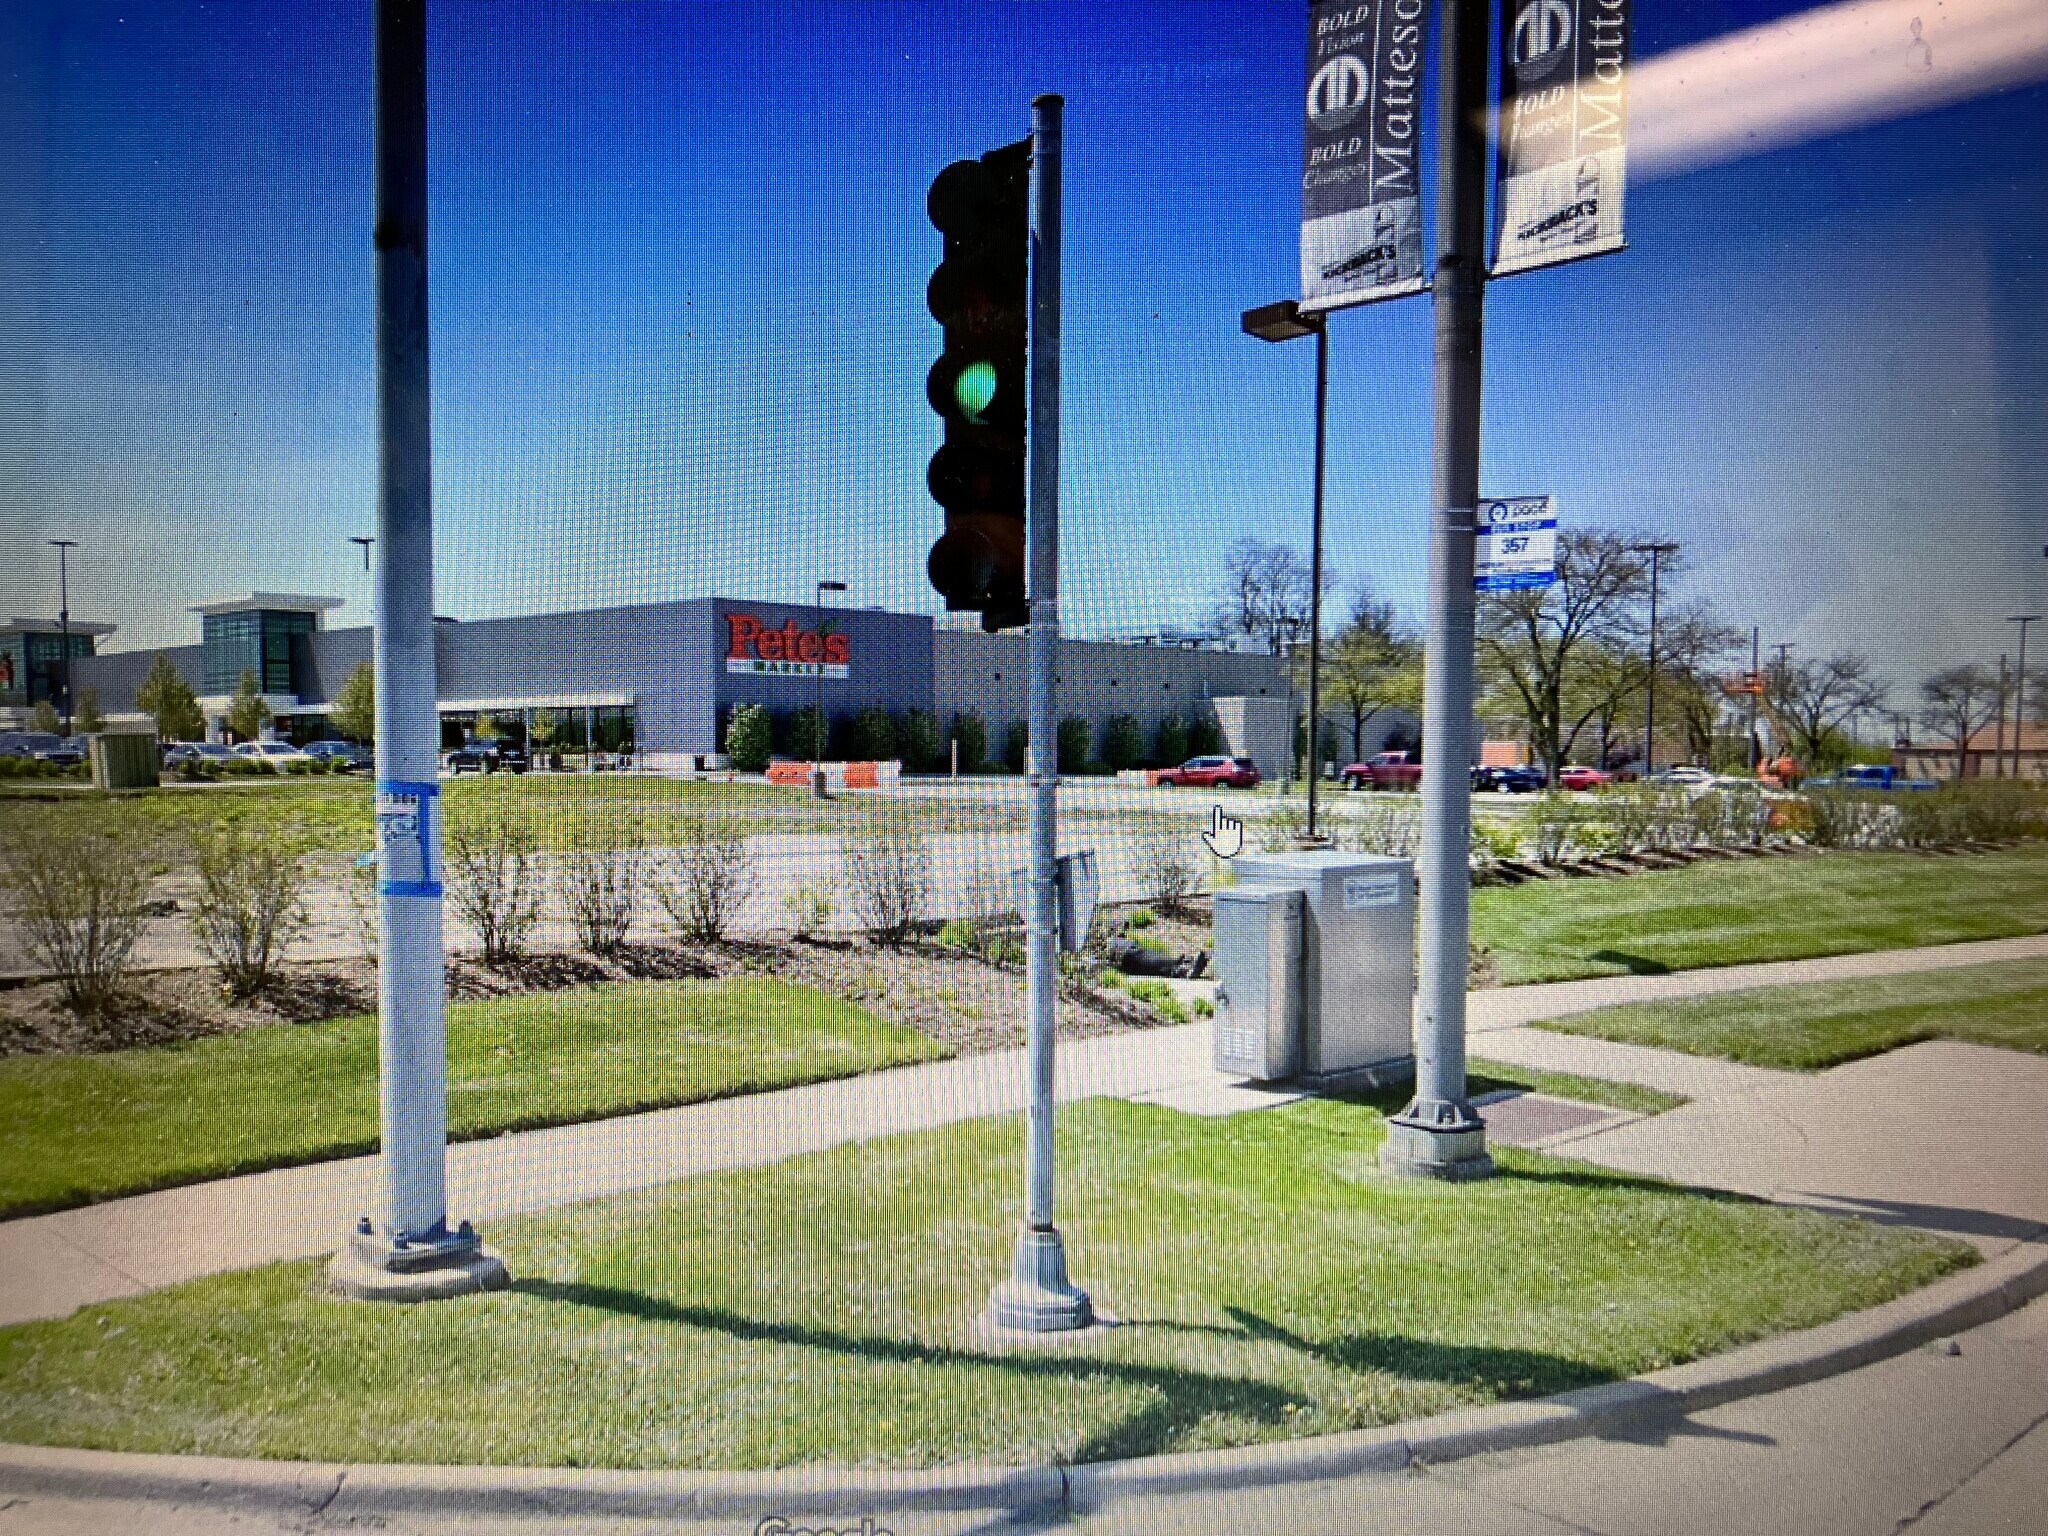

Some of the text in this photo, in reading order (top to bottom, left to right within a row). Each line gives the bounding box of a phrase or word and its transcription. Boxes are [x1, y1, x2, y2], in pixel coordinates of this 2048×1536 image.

[1317, 6, 1369, 34] BOLD
[1309, 138, 1361, 165] BOLD
[1501, 537, 1529, 554] 357
